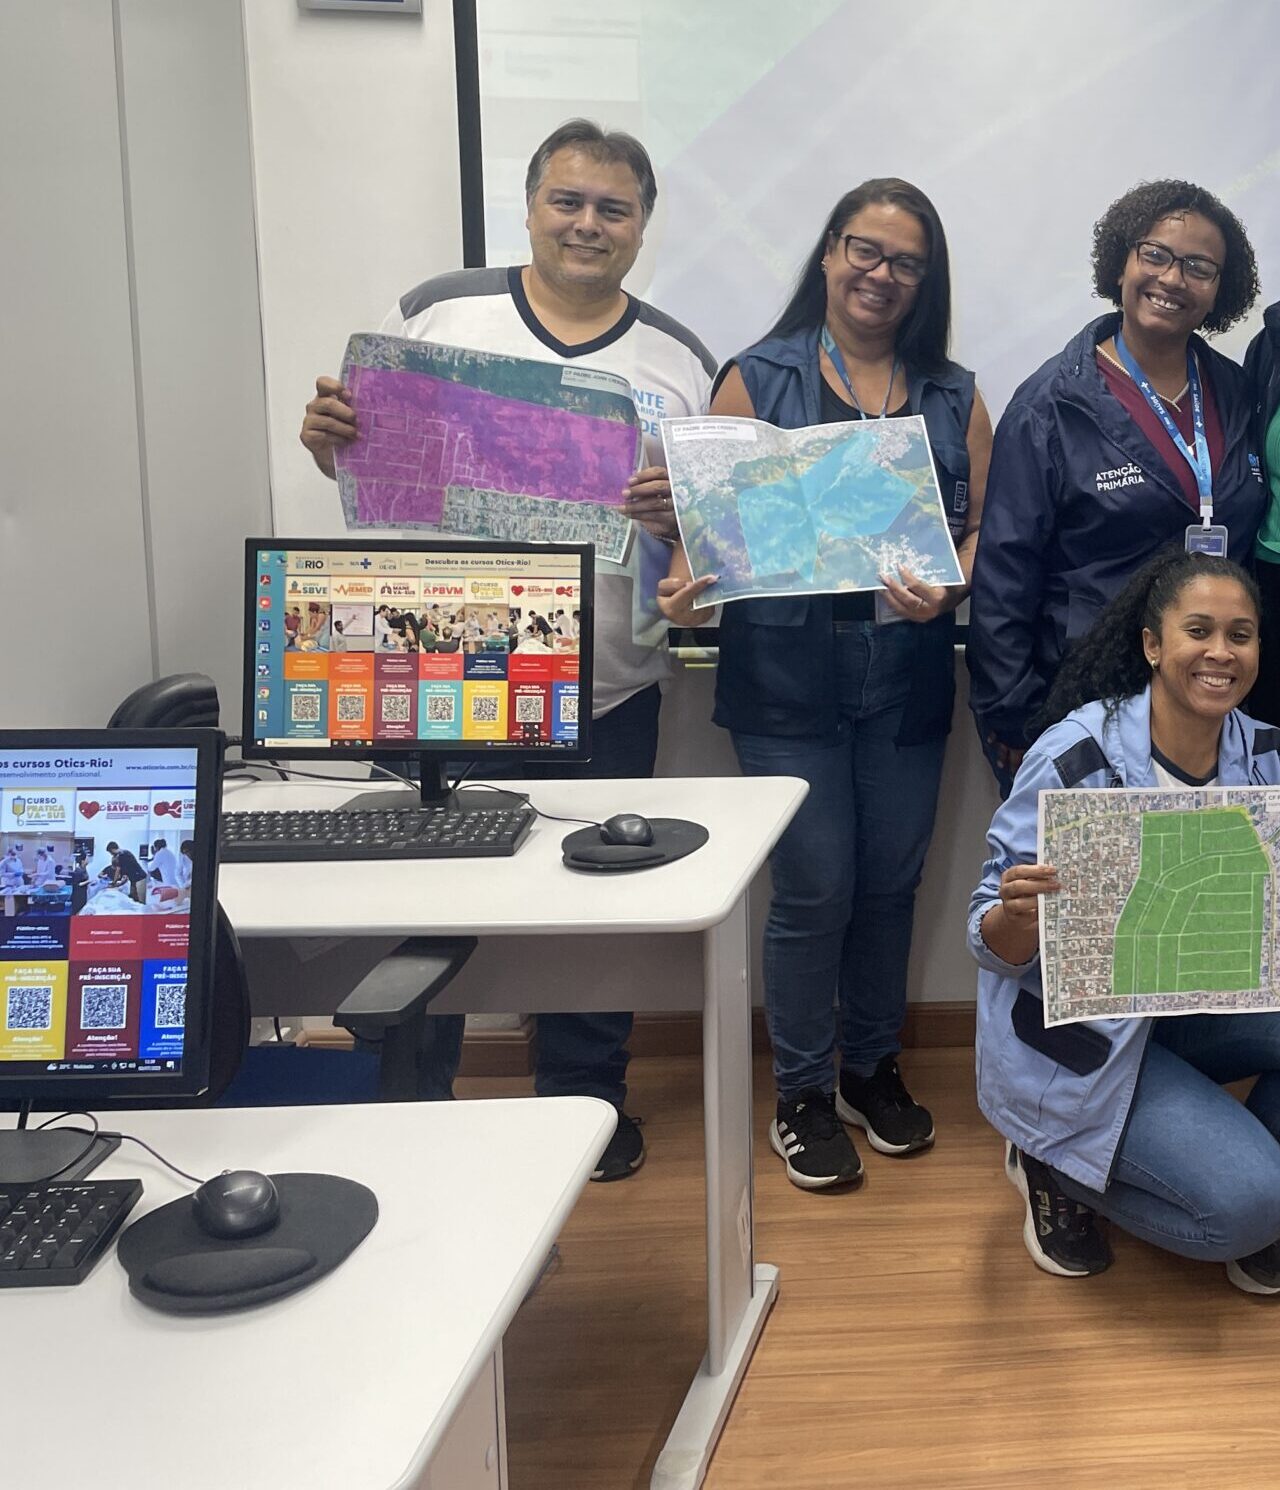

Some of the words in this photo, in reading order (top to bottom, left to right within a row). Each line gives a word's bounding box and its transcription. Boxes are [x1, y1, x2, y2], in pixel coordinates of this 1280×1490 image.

[633, 388, 665, 410] NTE
[640, 418, 659, 437] DE
[1096, 462, 1142, 482] ATENÇÃO
[1097, 475, 1145, 491] PRIMÁRIA
[305, 560, 324, 569] RIO
[495, 558, 531, 566] Otics-Rio!
[302, 586, 328, 594] SBVE
[432, 587, 463, 595] PBVM
[12, 760, 51, 768] cursos
[54, 758, 113, 768] Otics-Rio!
[106, 804, 149, 812] SAVE-RIO
[88, 967, 107, 975] FAÇA
[79, 973, 132, 982] PRÉ-INSCRIÇÃO
[1035, 1190, 1054, 1236] FILA
